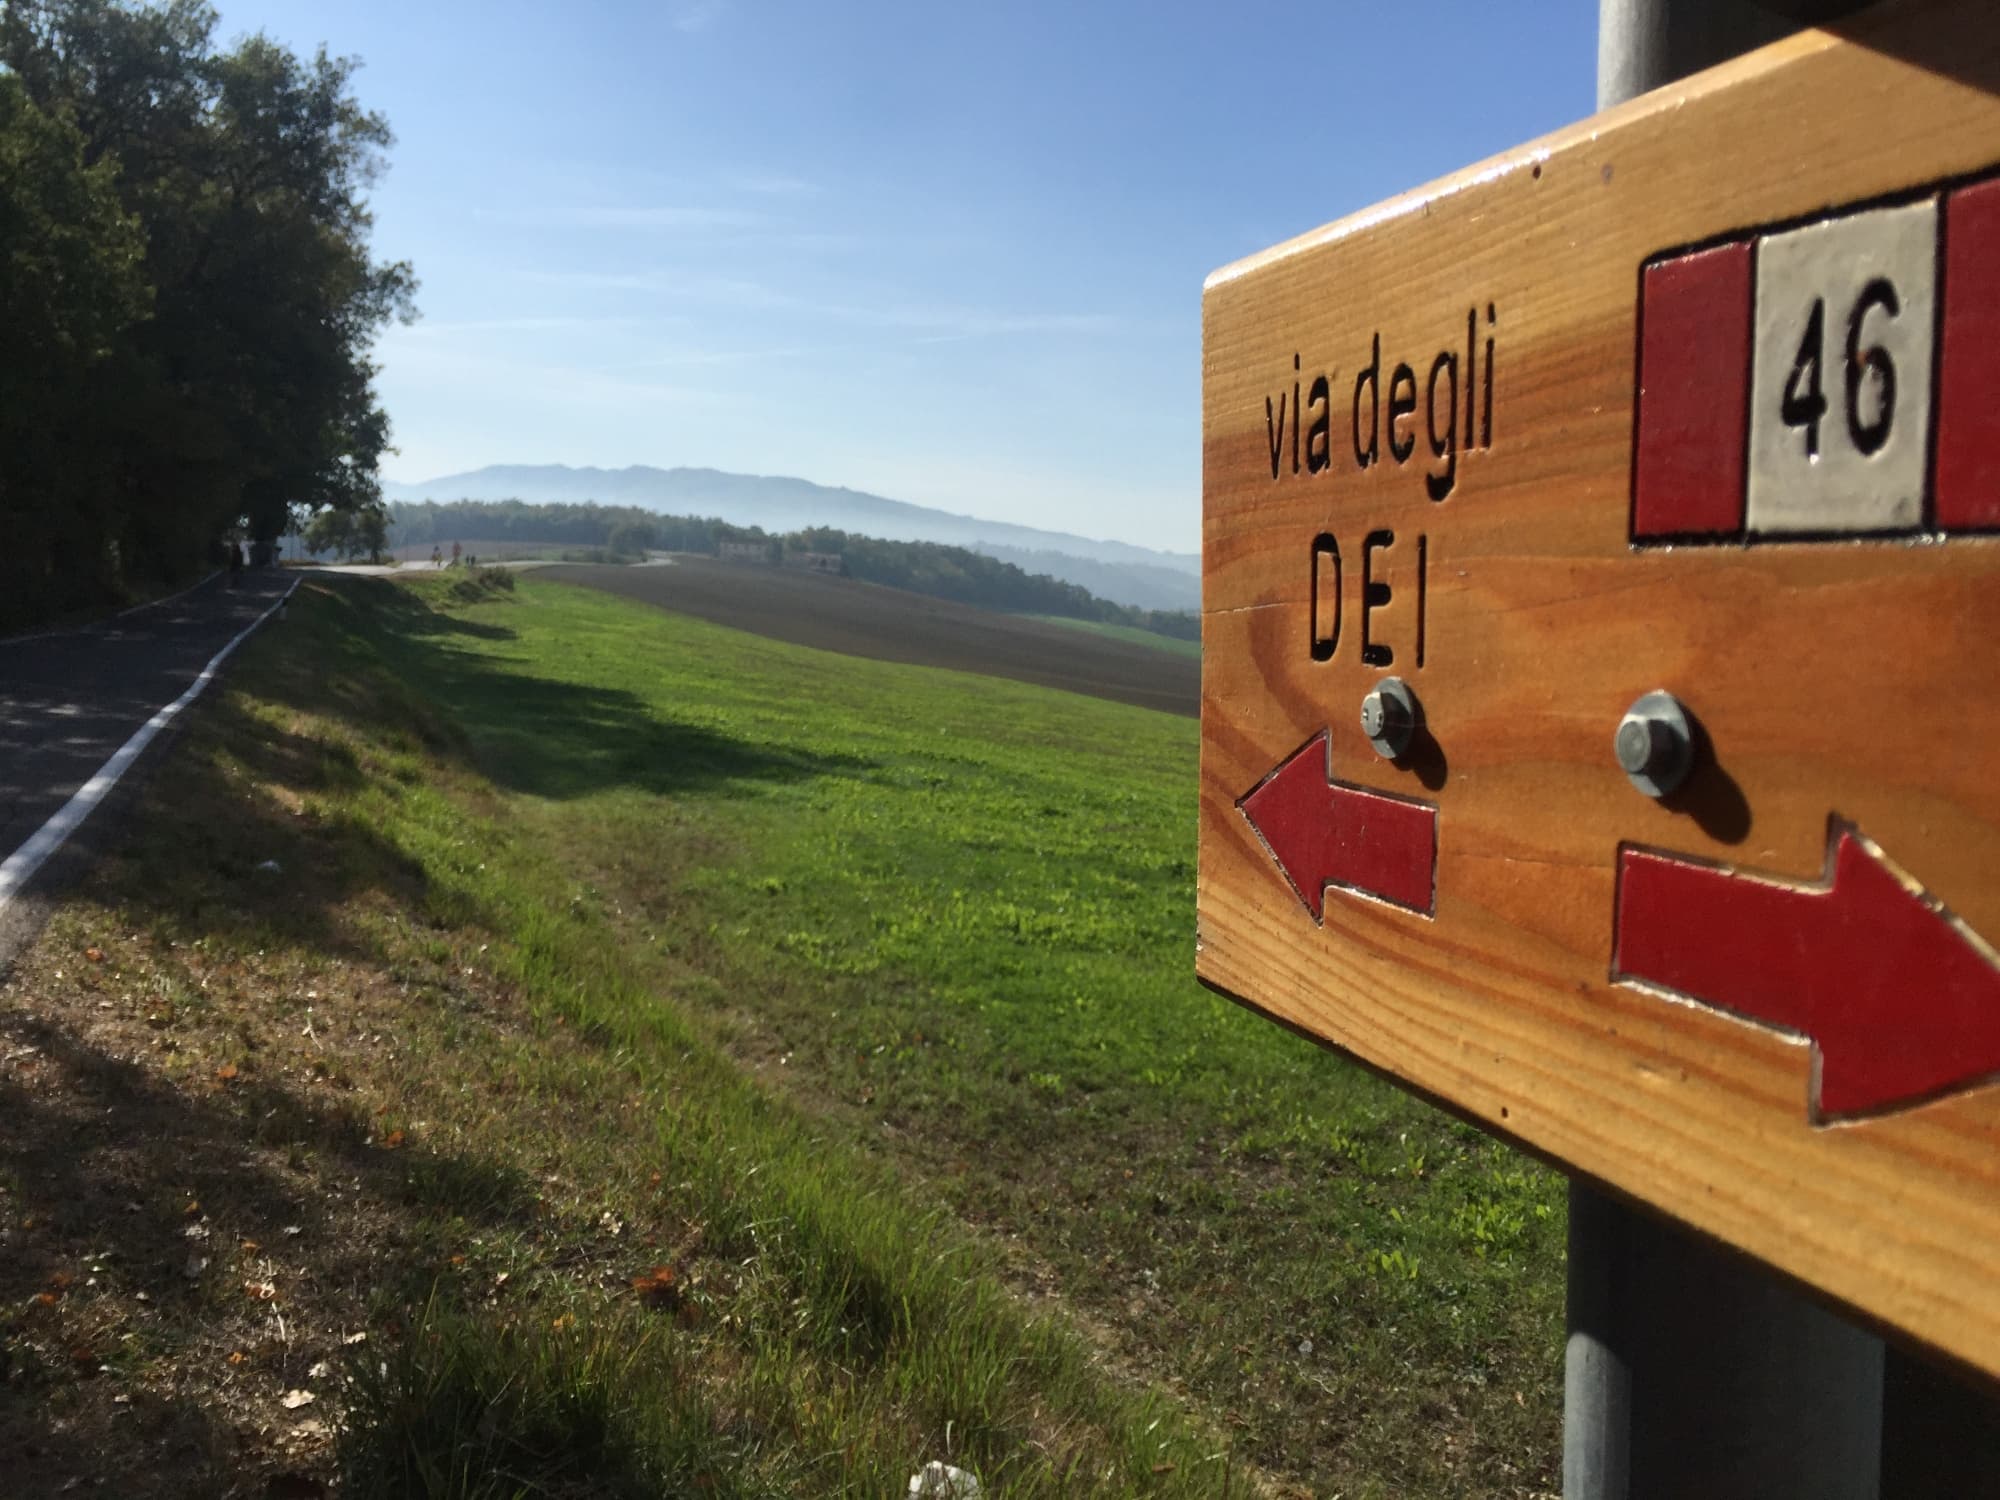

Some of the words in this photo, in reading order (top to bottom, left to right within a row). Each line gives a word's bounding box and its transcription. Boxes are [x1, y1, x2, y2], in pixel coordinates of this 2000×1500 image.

[1265, 352, 1332, 481] via
[1352, 301, 1496, 503] degli
[1780, 276, 1900, 461] 46
[1309, 528, 1428, 670] DEI
